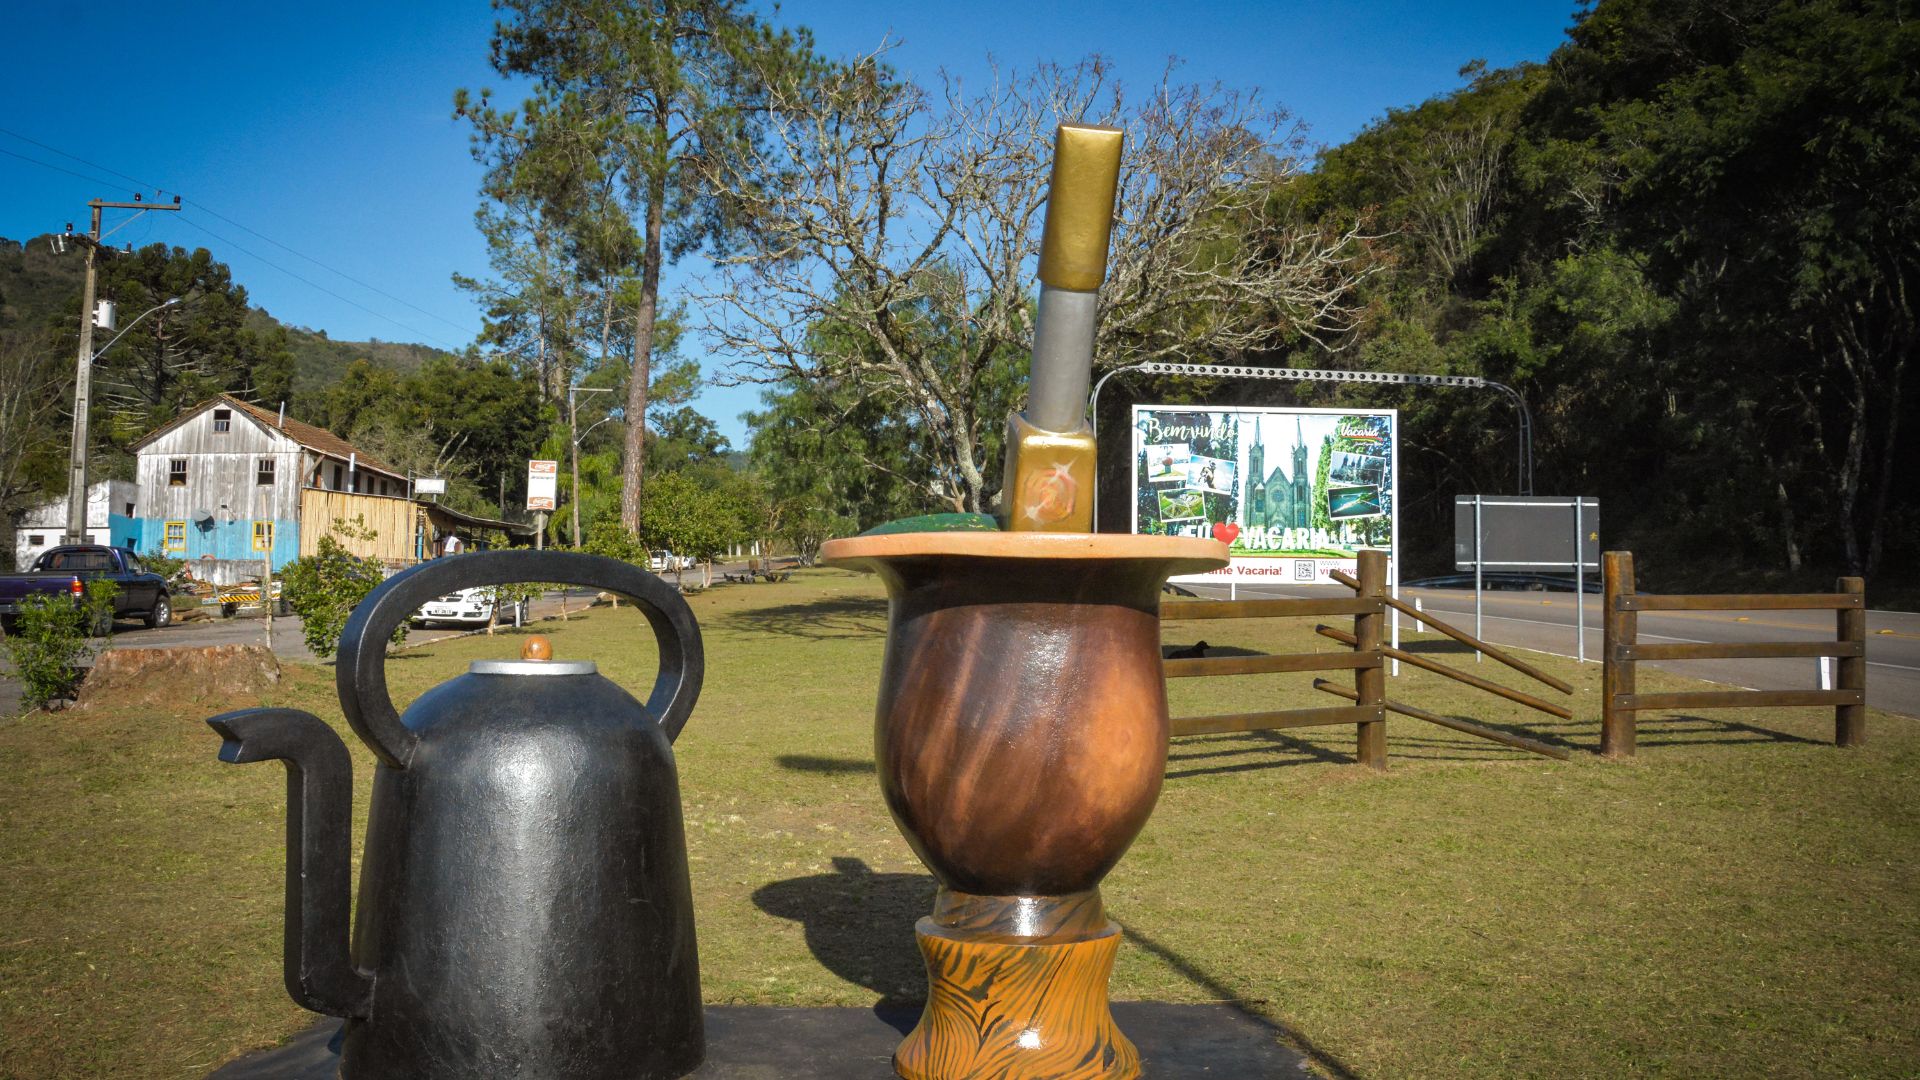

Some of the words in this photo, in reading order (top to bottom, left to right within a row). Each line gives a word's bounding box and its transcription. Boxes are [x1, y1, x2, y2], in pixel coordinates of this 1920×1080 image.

[1339, 423, 1379, 436] Vacaria
[1242, 527, 1328, 550] VACARIA
[1237, 566, 1282, 576] Vacaria!
